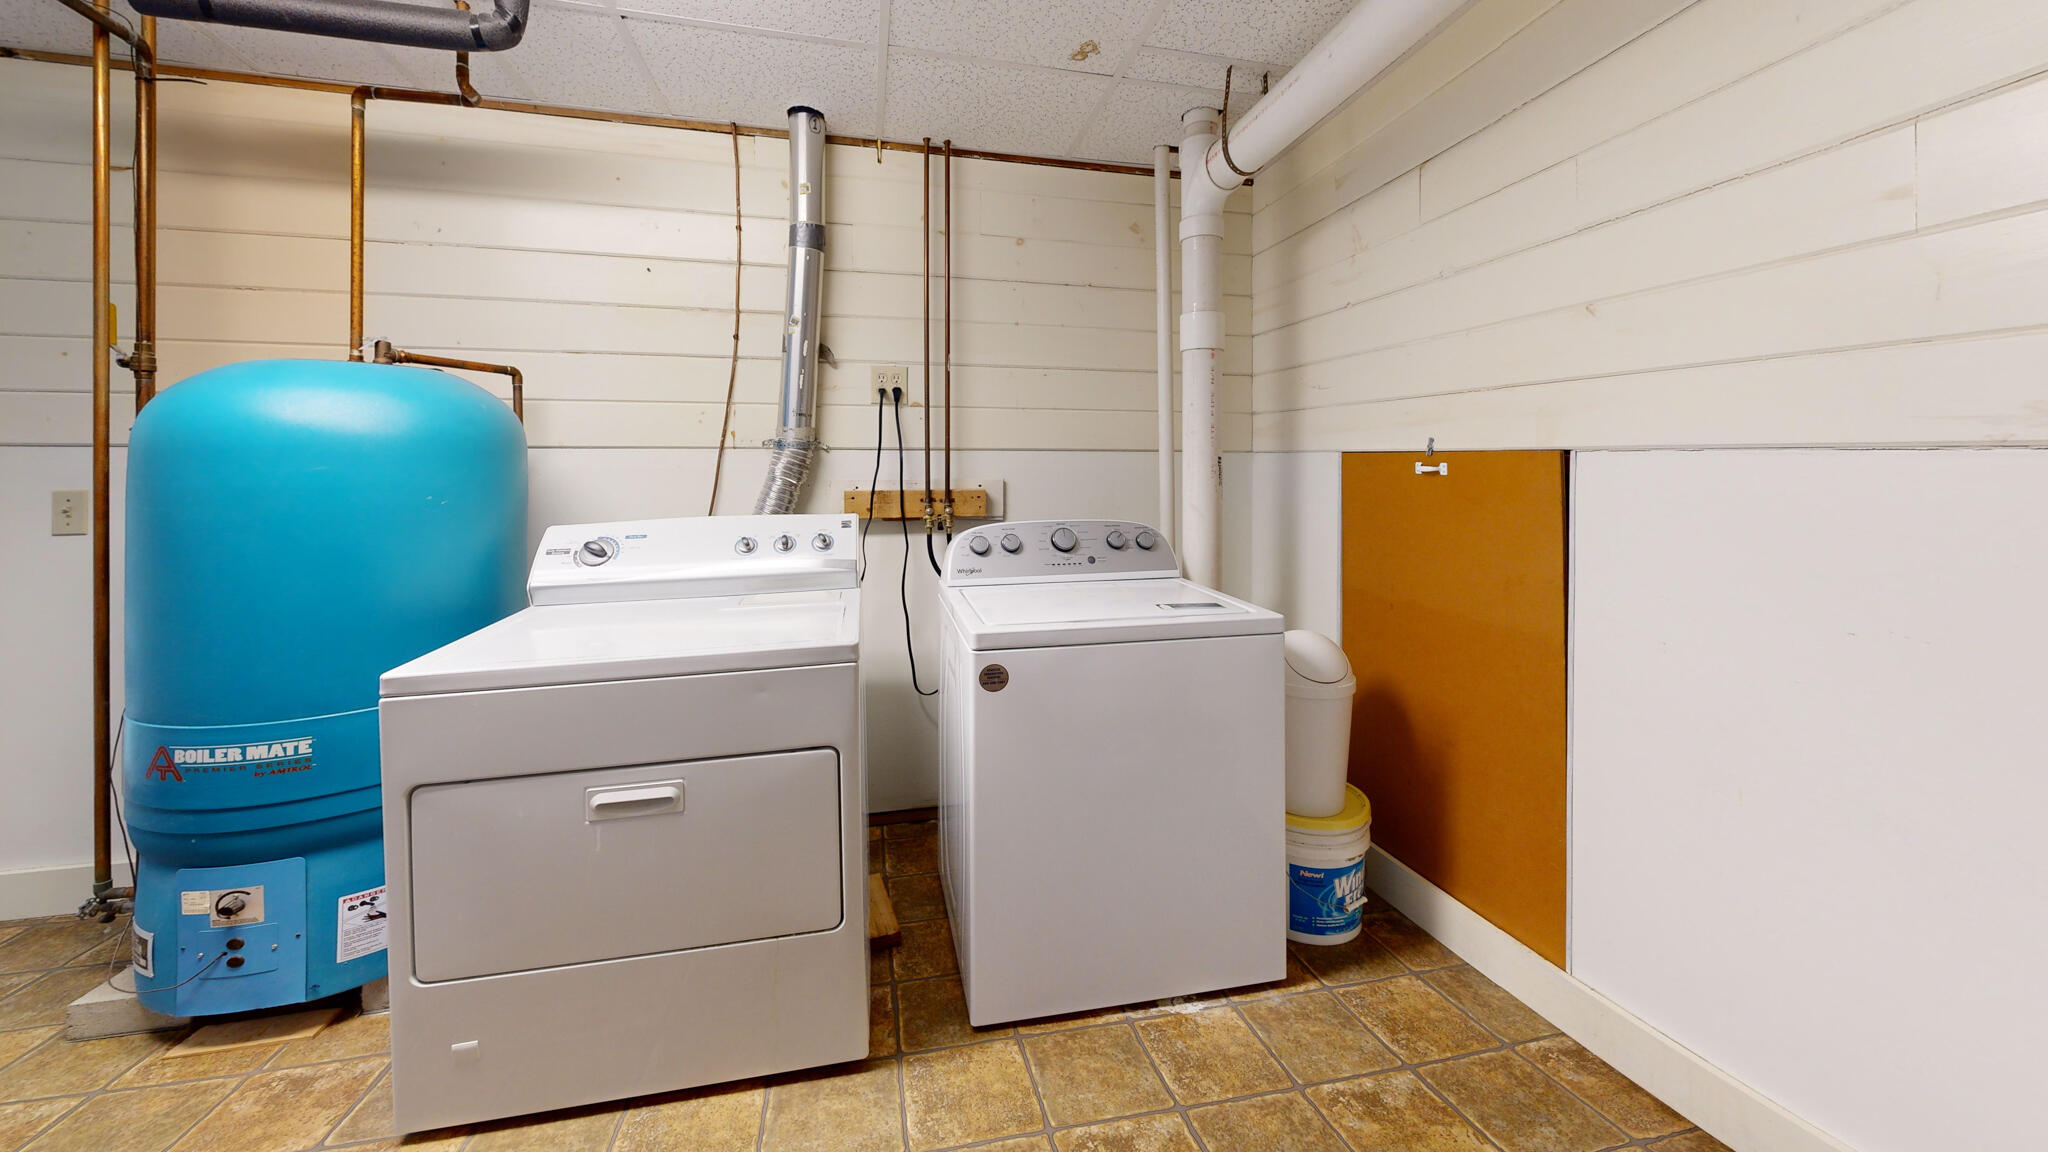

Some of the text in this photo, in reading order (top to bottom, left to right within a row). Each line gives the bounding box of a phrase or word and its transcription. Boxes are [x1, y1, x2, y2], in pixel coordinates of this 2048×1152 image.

[956, 567, 983, 576] Whirlpool
[174, 739, 312, 764] BOILER MATE
[184, 757, 313, 774] PREMIER SERIES
[254, 770, 264, 778] by
